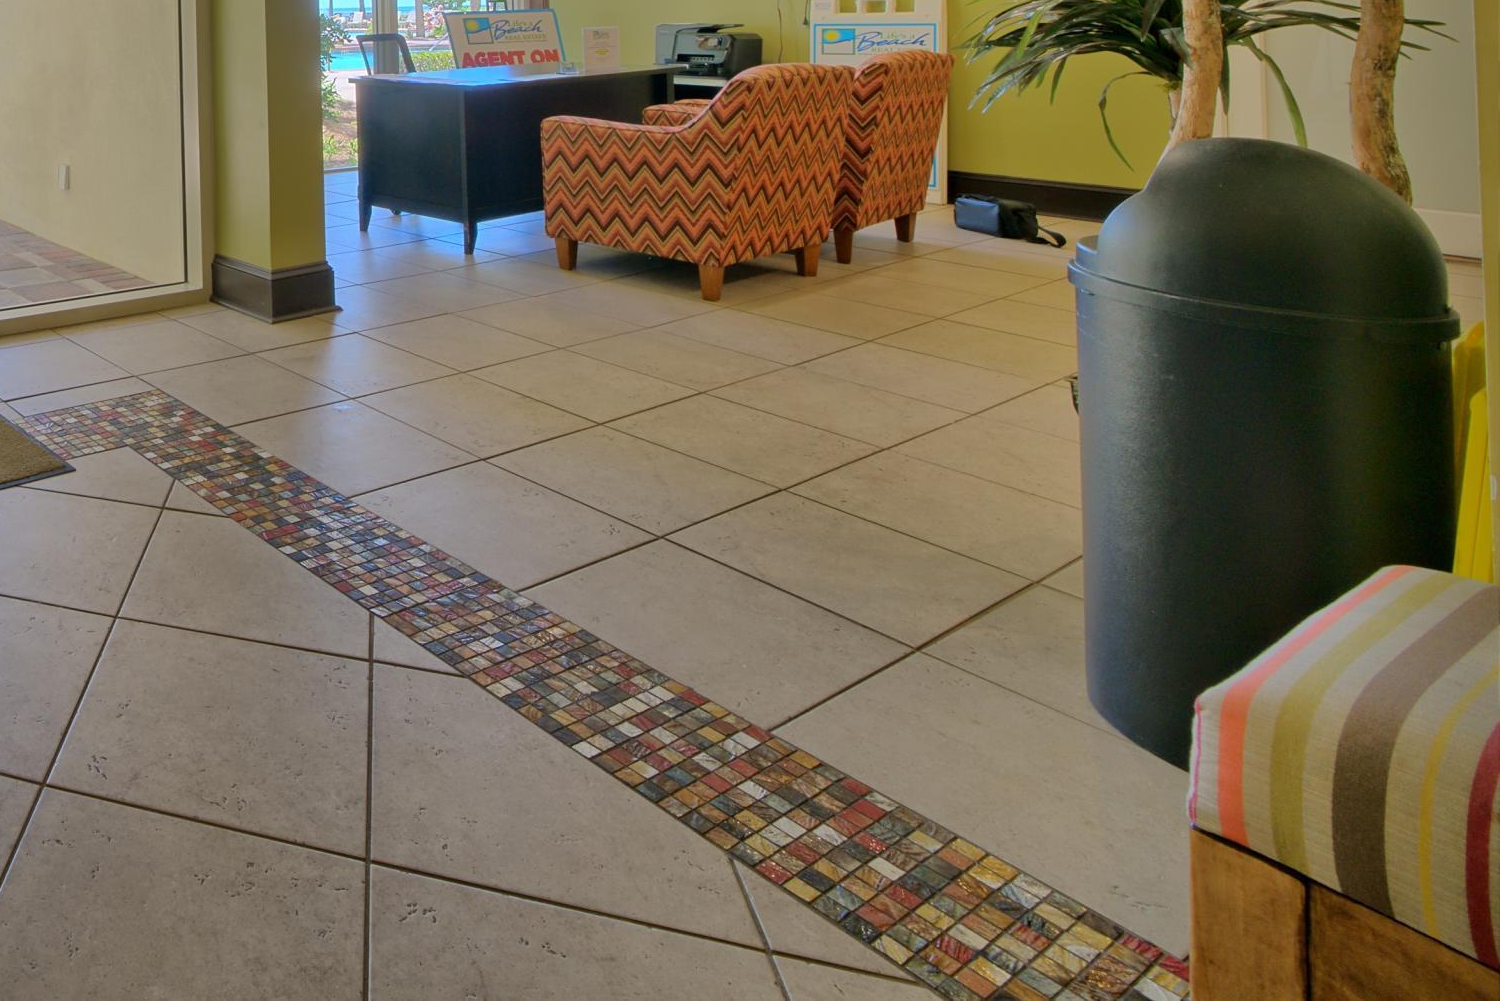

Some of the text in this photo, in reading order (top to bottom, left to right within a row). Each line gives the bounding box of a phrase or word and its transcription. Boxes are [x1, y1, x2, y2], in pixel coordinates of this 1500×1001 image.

[491, 19, 543, 40] Beach
[856, 31, 930, 52] Beach
[462, 49, 560, 68] AGENT ON
